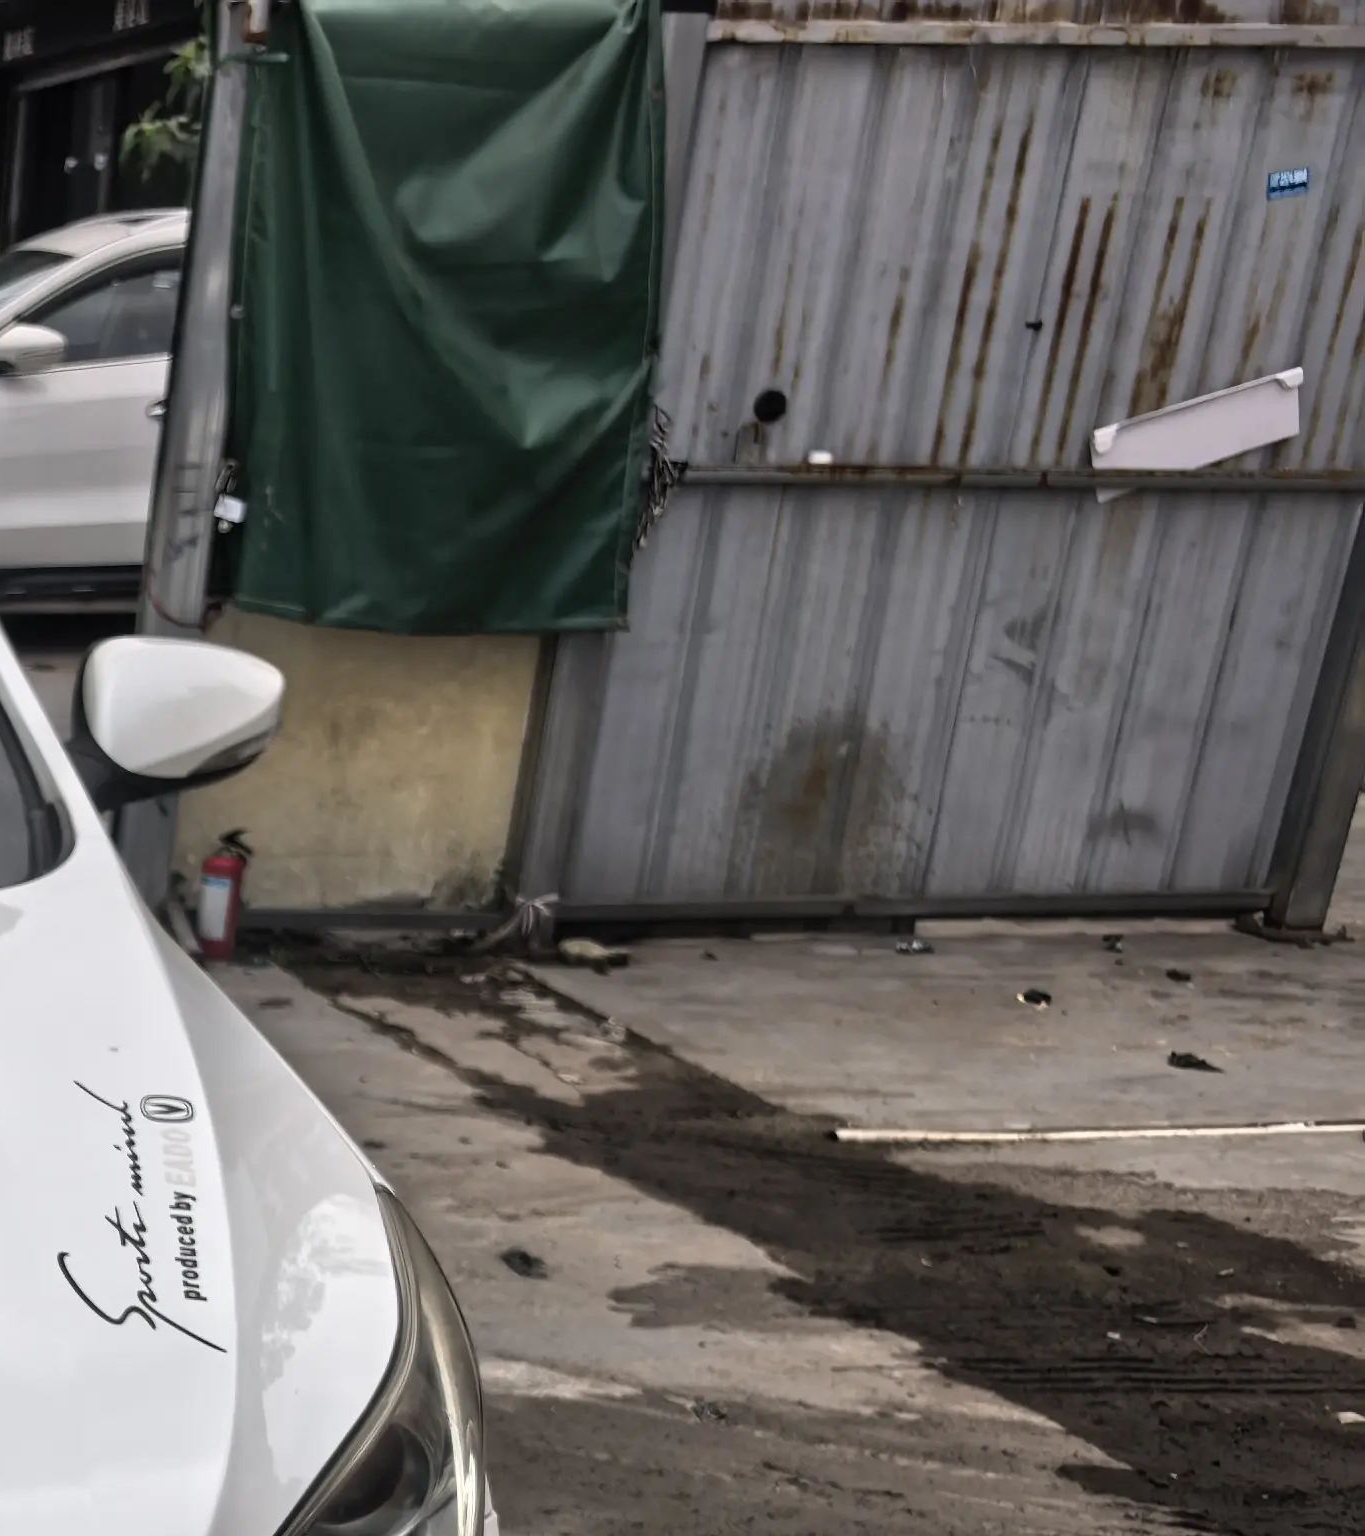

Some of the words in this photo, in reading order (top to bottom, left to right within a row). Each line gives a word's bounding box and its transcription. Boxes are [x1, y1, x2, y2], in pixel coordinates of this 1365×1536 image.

[160, 1128, 196, 1189] EADO
[169, 1191, 196, 1211] by
[170, 1214, 207, 1301] produced
